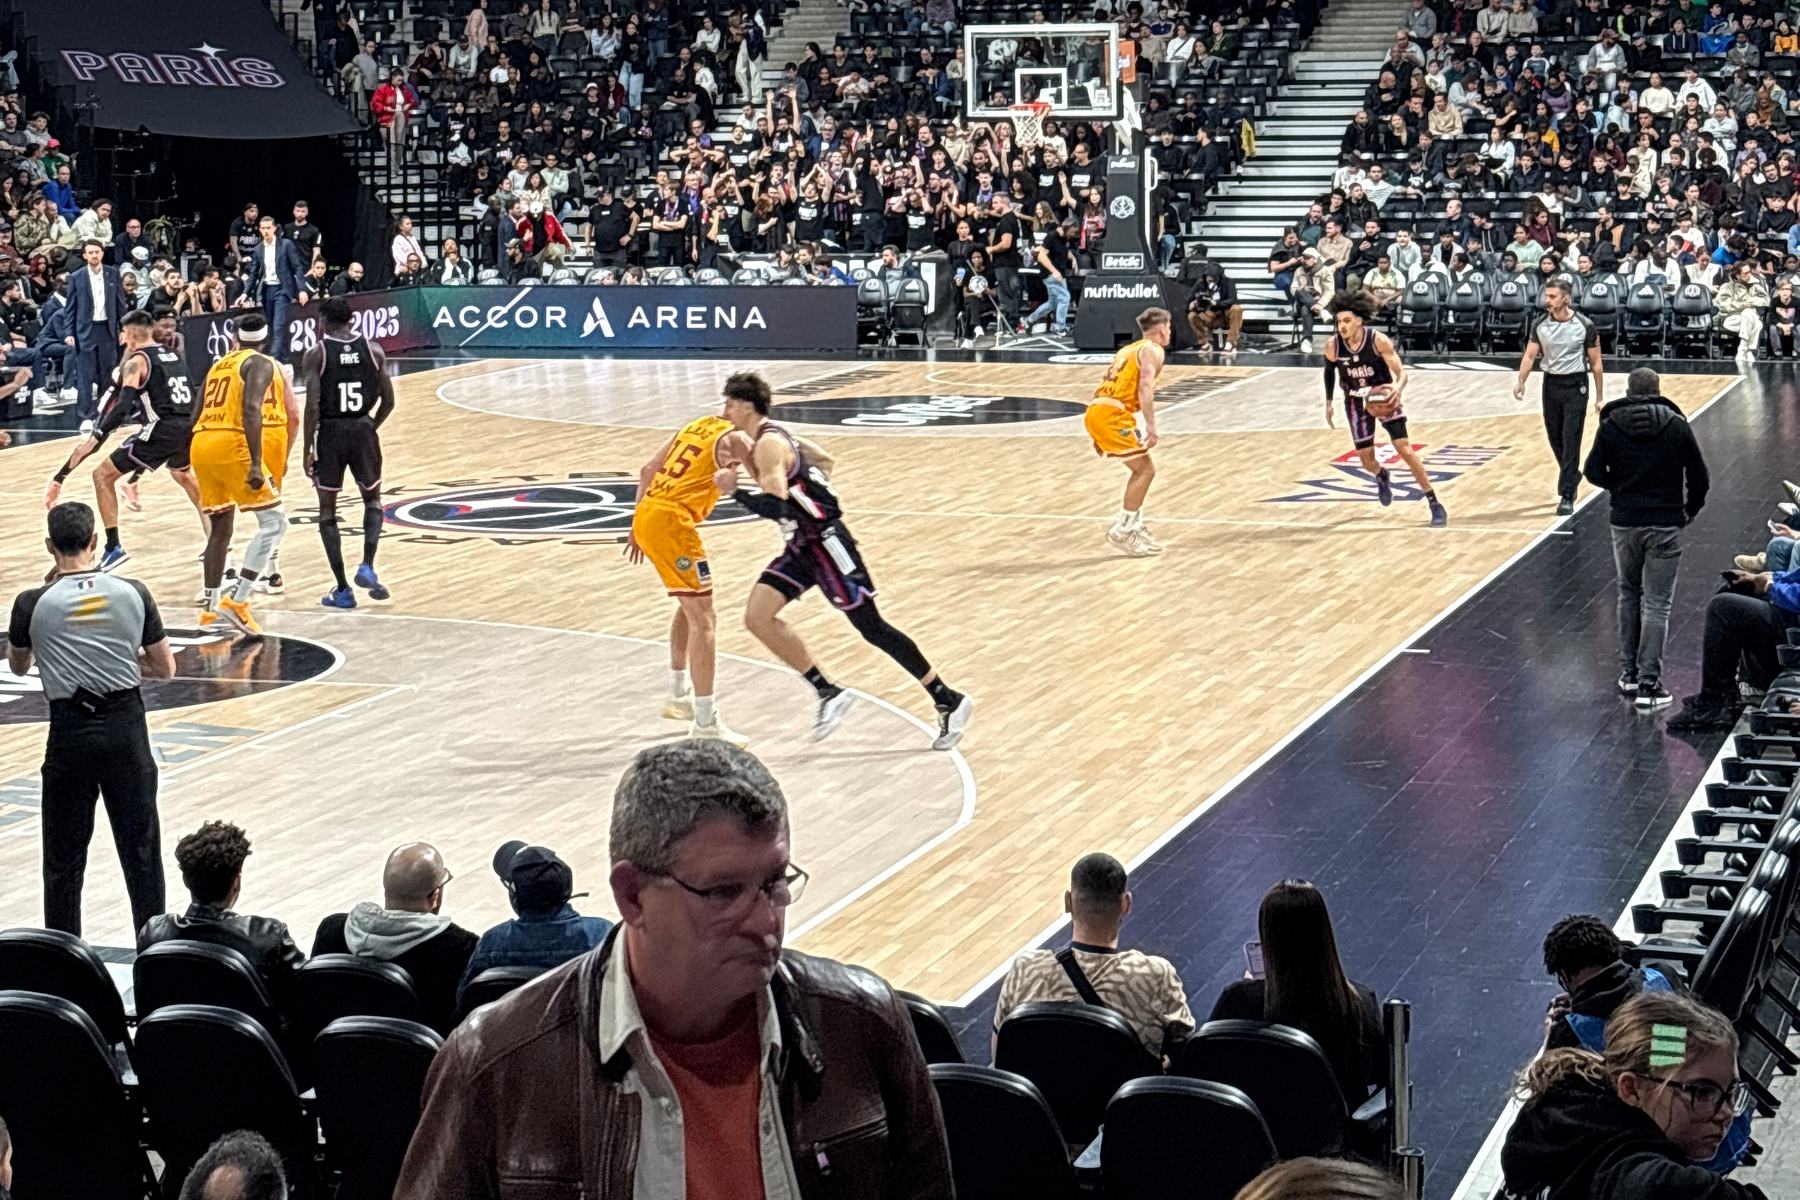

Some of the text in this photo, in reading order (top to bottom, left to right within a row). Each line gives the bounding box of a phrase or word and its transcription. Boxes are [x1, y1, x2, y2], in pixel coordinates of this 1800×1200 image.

[60, 49, 286, 89] PARIS
[1105, 256, 1140, 267] Betclic
[290, 305, 400, 352] 28 2025
[432, 306, 767, 329] ACCOR ARENA
[1346, 364, 1374, 378] PARIS
[1359, 378, 1367, 386] 2
[168, 376, 192, 404] 35
[204, 376, 231, 408] 20
[338, 382, 363, 413] 15
[657, 440, 703, 479] 15
